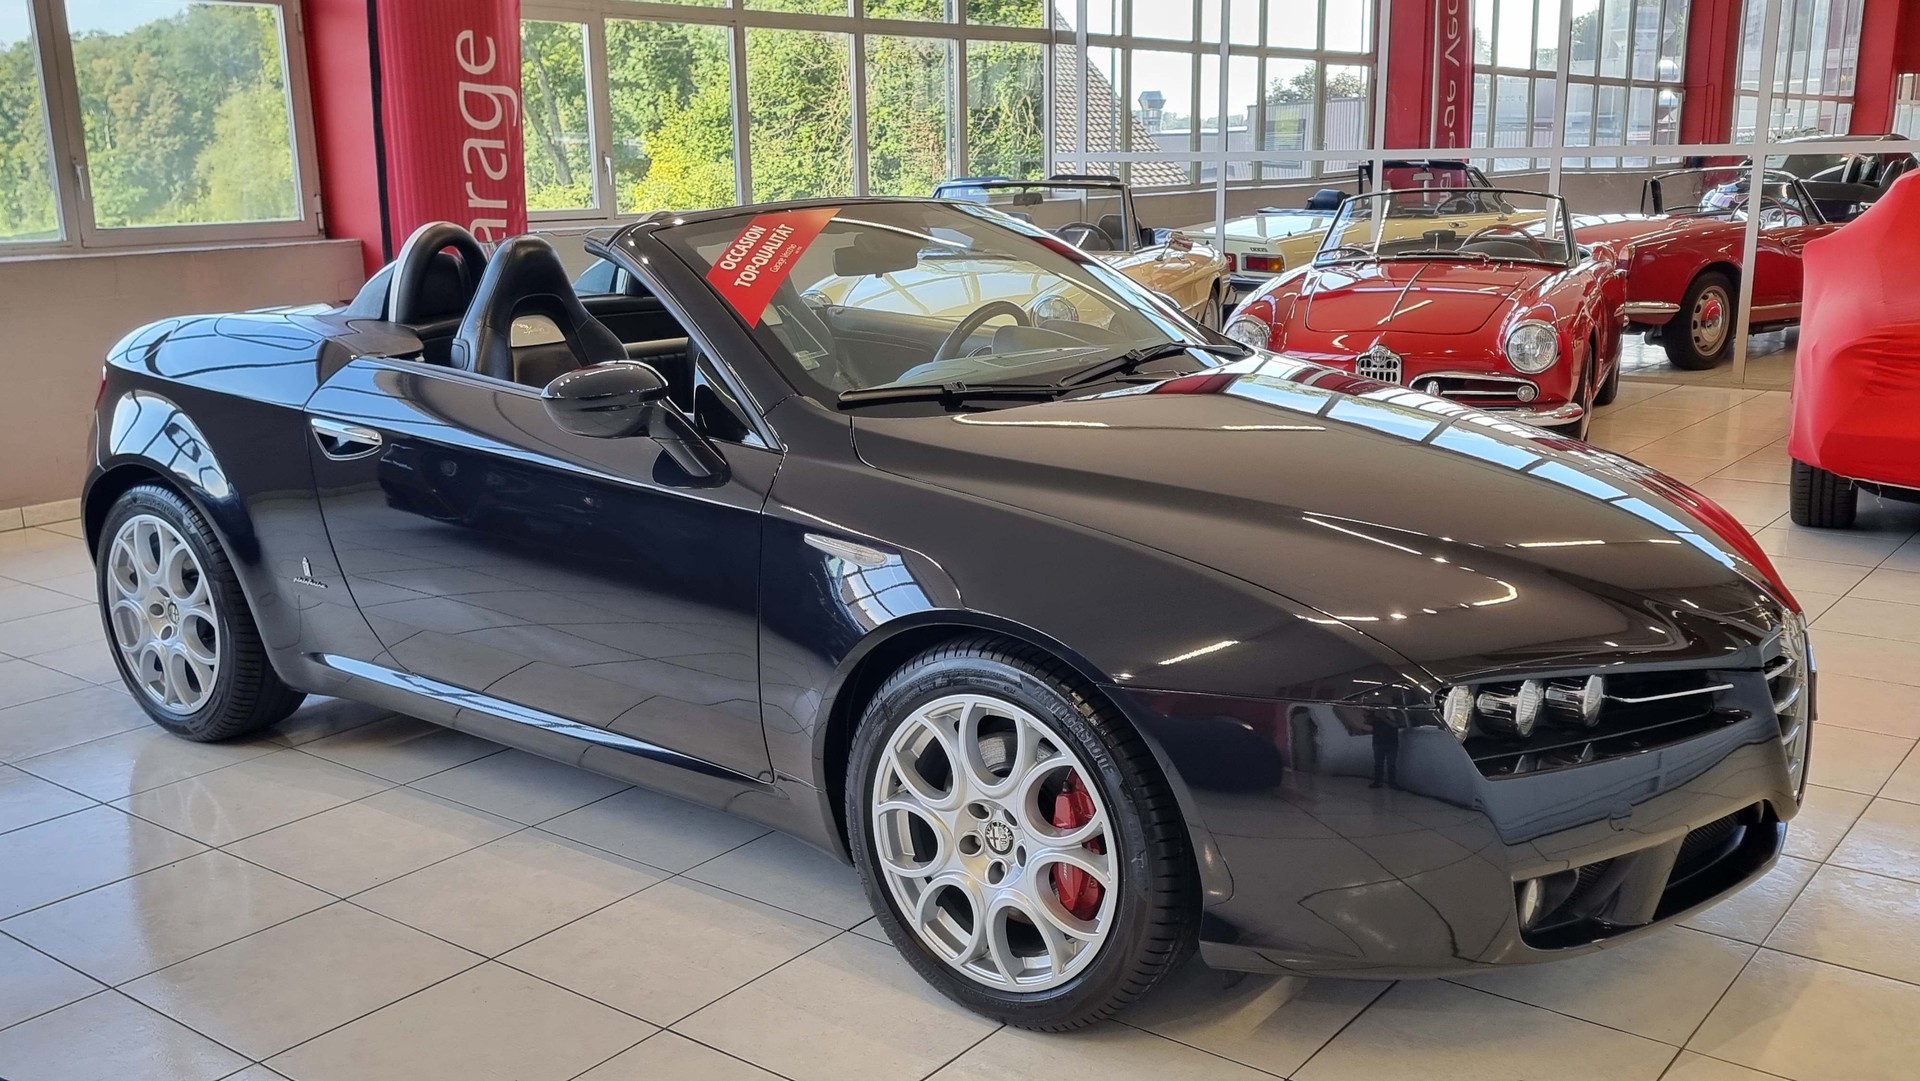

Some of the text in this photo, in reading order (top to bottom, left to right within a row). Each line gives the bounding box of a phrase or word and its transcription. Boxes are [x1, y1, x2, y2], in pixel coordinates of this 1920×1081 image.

[455, 29, 518, 246] arage
[720, 225, 767, 270] OCCASION
[733, 223, 795, 287] TOP-QUALITÄT
